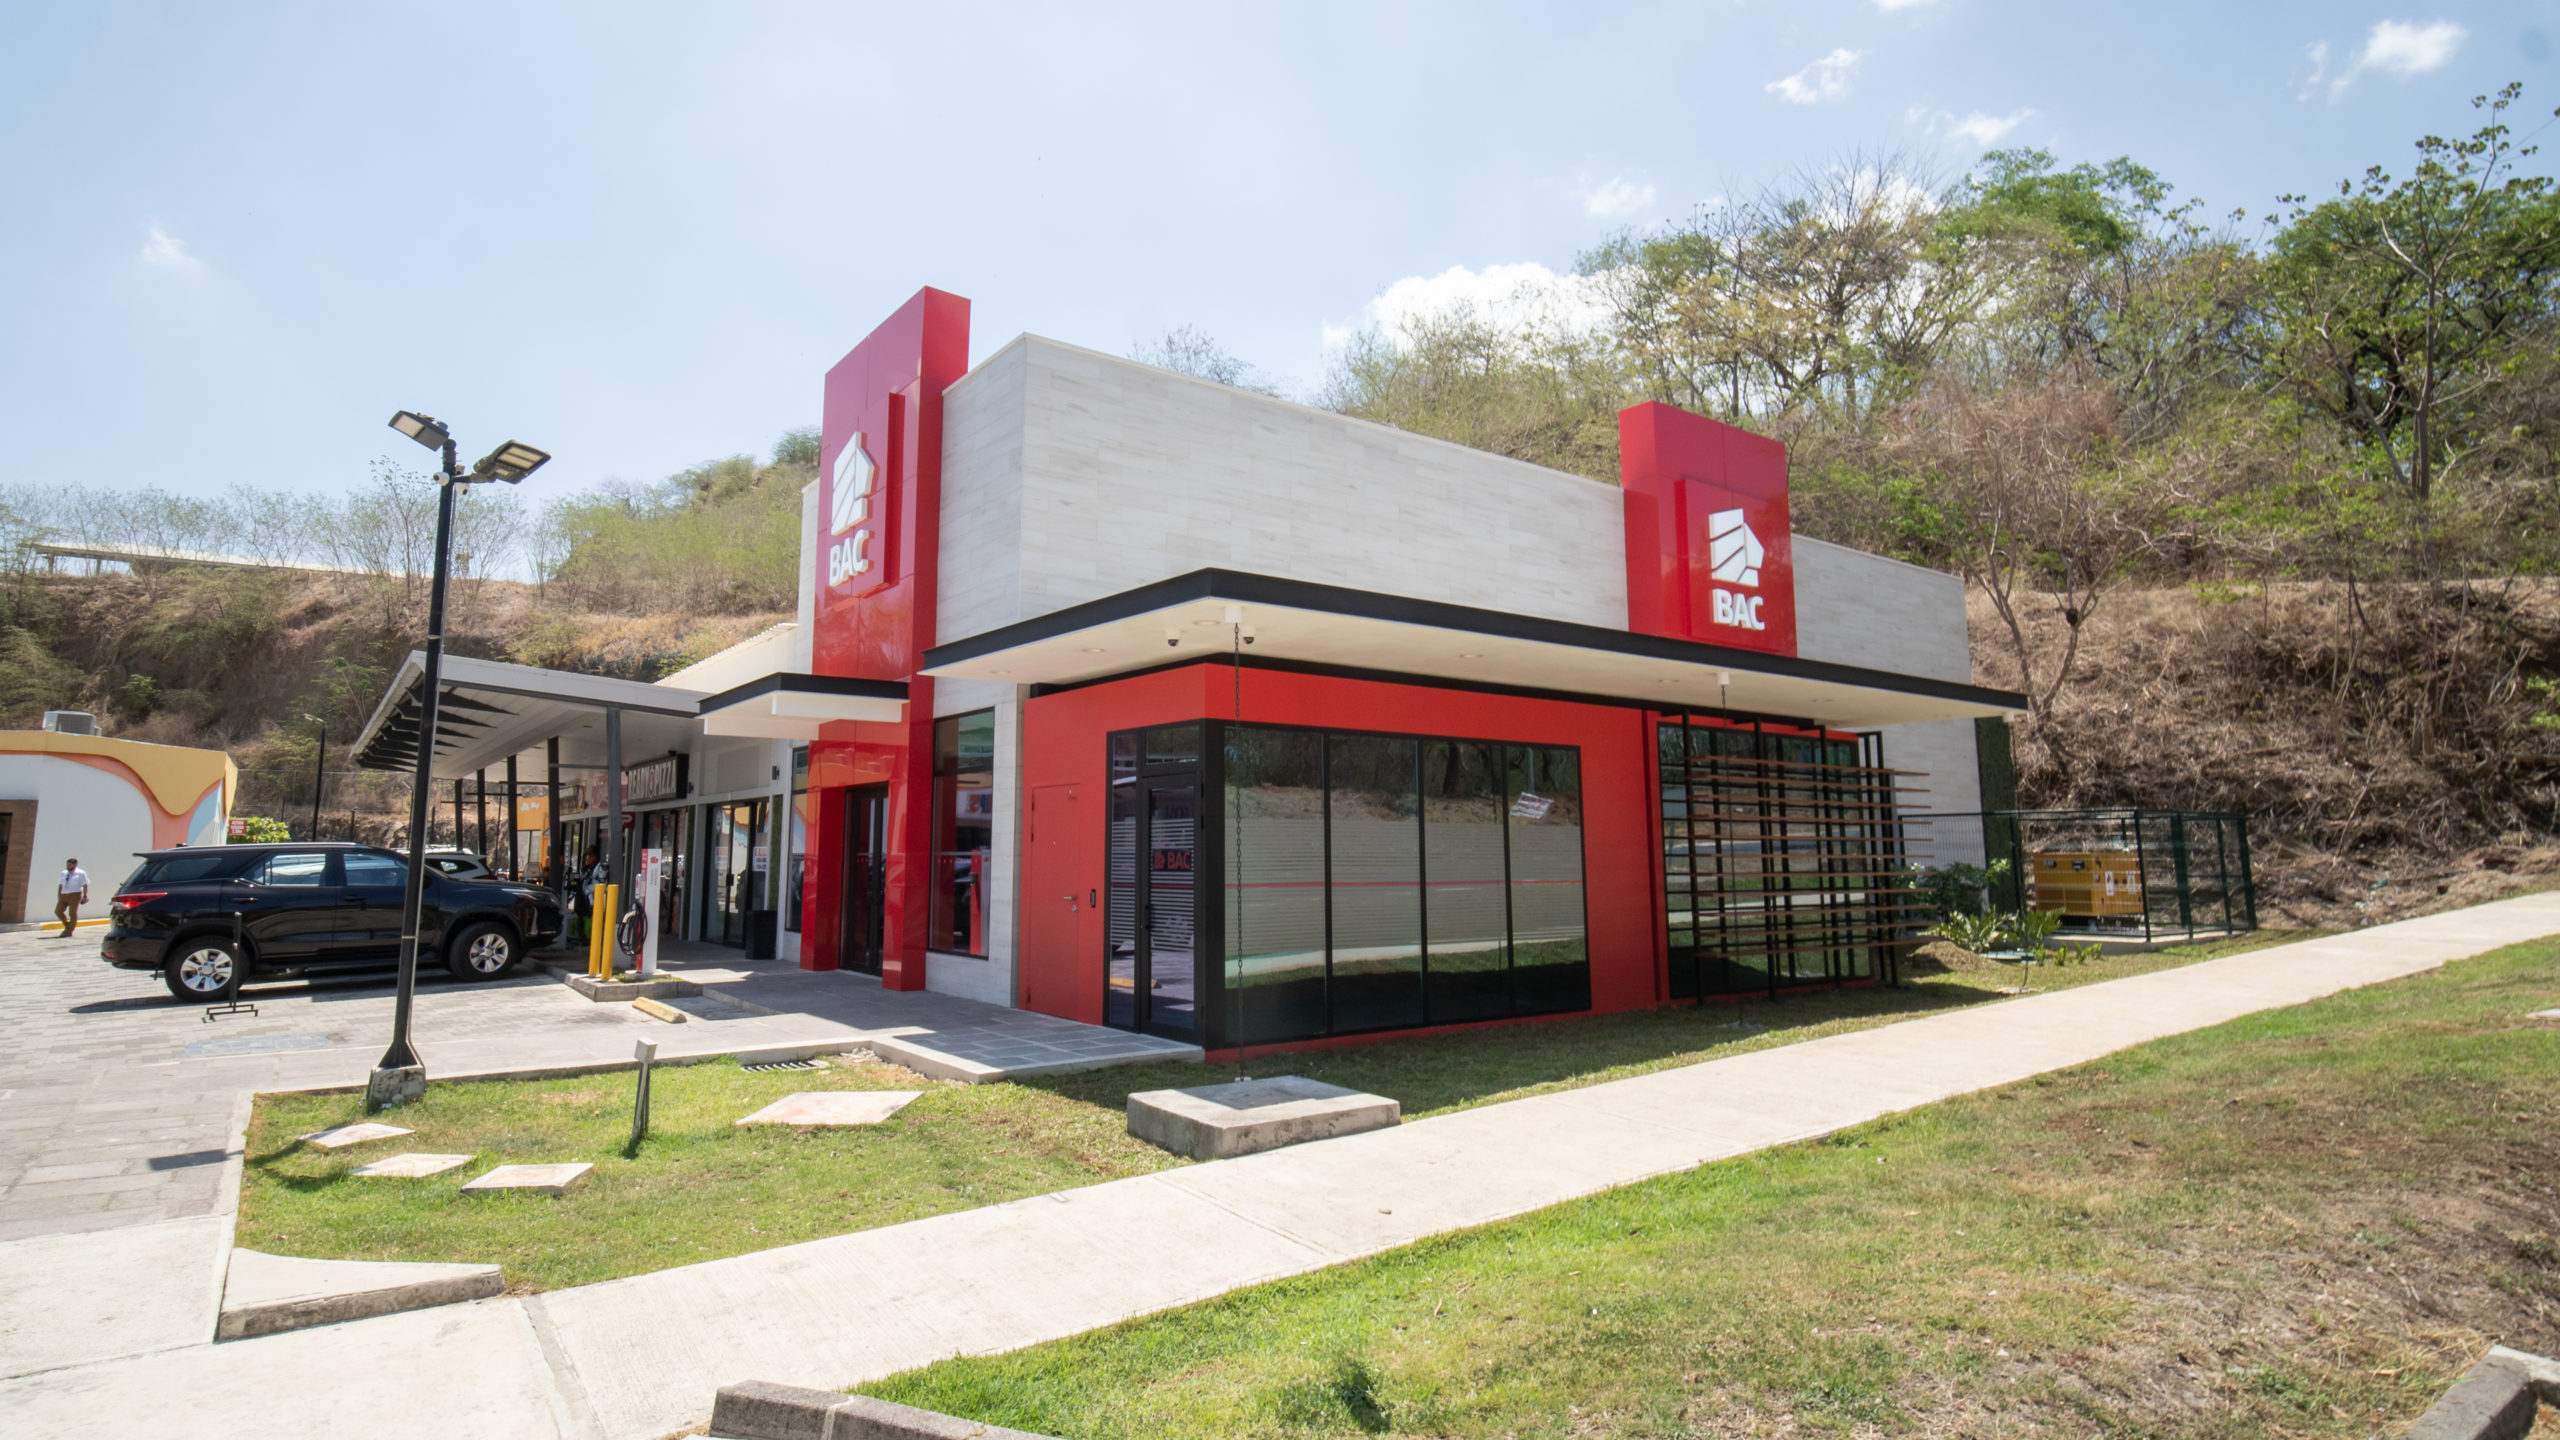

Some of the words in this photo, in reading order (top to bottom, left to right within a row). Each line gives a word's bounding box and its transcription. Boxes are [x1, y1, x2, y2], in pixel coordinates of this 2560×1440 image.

[829, 529, 870, 586] BAC
[1712, 588, 1765, 630] BAC
[628, 767, 650, 800] READY
[654, 760, 676, 796] PIZZA
[1167, 850, 1191, 870] BAC
